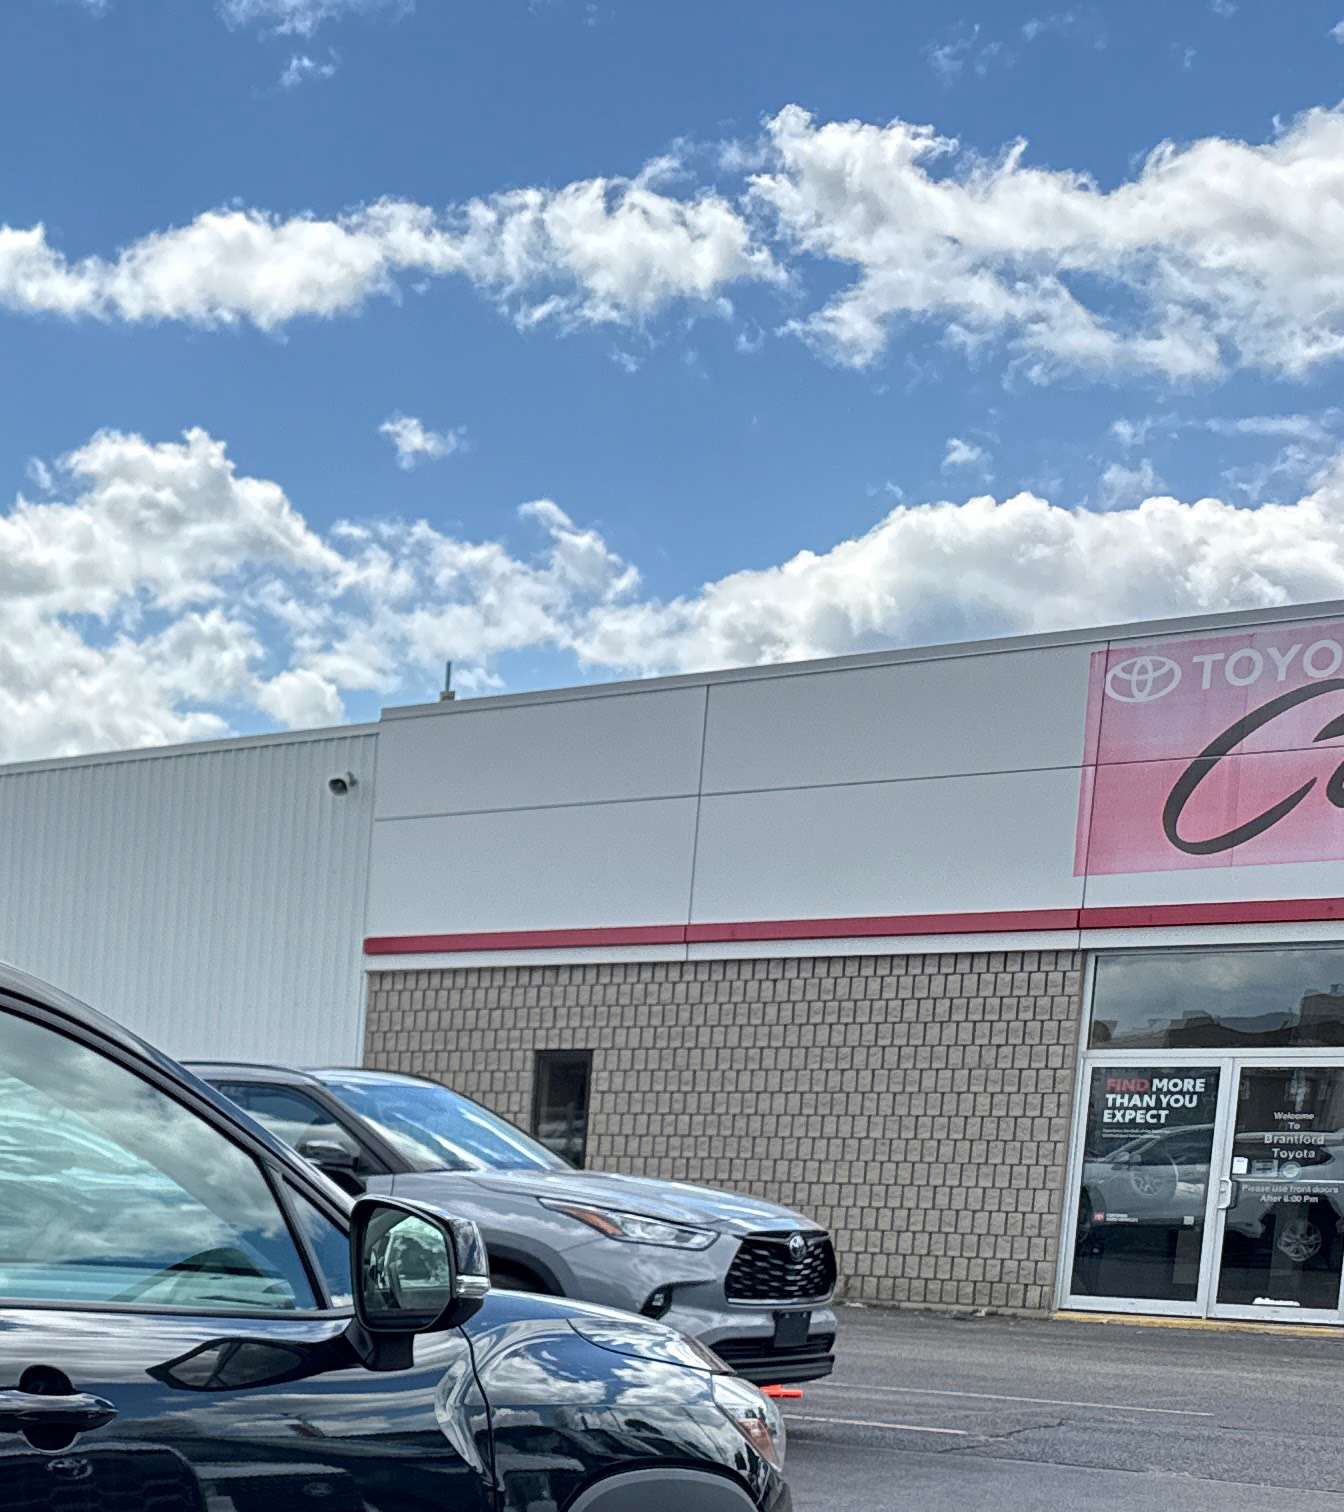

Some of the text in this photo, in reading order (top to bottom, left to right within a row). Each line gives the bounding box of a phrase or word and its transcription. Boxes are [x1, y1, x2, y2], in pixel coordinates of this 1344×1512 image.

[1107, 1078, 1207, 1092] FIND MORE
[1105, 1094, 1198, 1108] THAN YOU
[1103, 1110, 1170, 1124] EXPECT
[1274, 1112, 1315, 1120] Welcome
[1288, 1122, 1301, 1130] To
[1264, 1134, 1325, 1145] Brantford
[1272, 1148, 1316, 1160] Toyota
